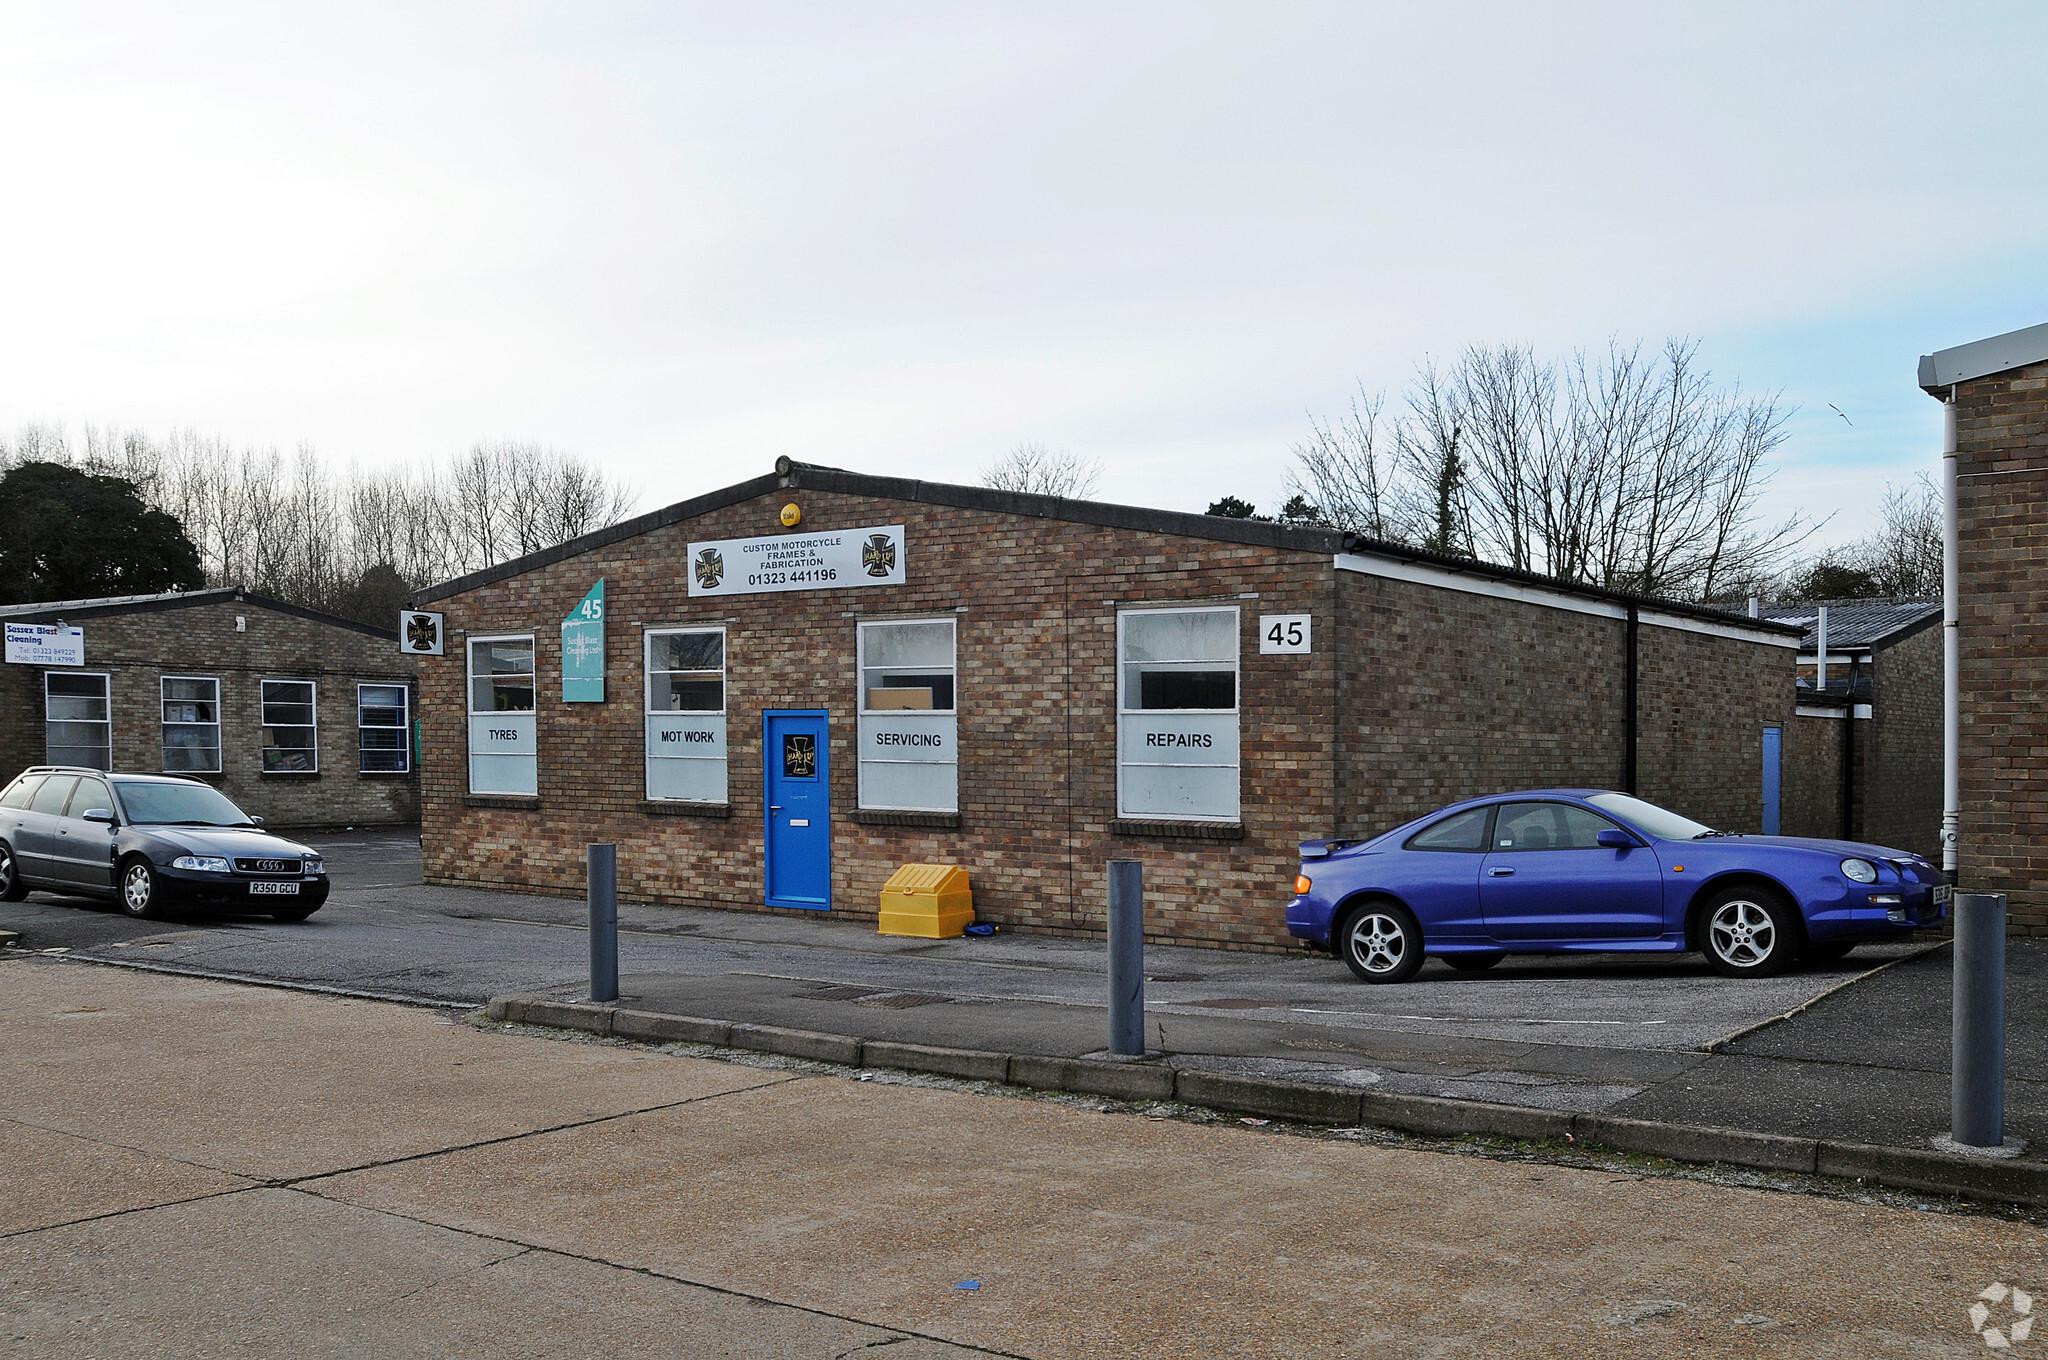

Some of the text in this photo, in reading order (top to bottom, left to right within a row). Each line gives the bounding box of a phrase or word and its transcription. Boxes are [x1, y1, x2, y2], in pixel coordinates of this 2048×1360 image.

[782, 512, 795, 520] Yale
[743, 538, 842, 553] CUSTOM MOTORCYCLE
[767, 549, 816, 560] FRAMES &
[760, 558, 824, 570] FABRICATION
[748, 568, 837, 585] 01323 441196
[581, 599, 602, 619] 45
[37, 627, 58, 635] Blast
[1267, 621, 1303, 646] 45
[6, 635, 42, 645] Cleaning
[489, 729, 518, 740] TYRES
[661, 731, 715, 743] MOT WORK
[876, 732, 942, 747] SERVICING
[1146, 733, 1212, 748] REPAIRS
[252, 883, 297, 893] R350 GCU
